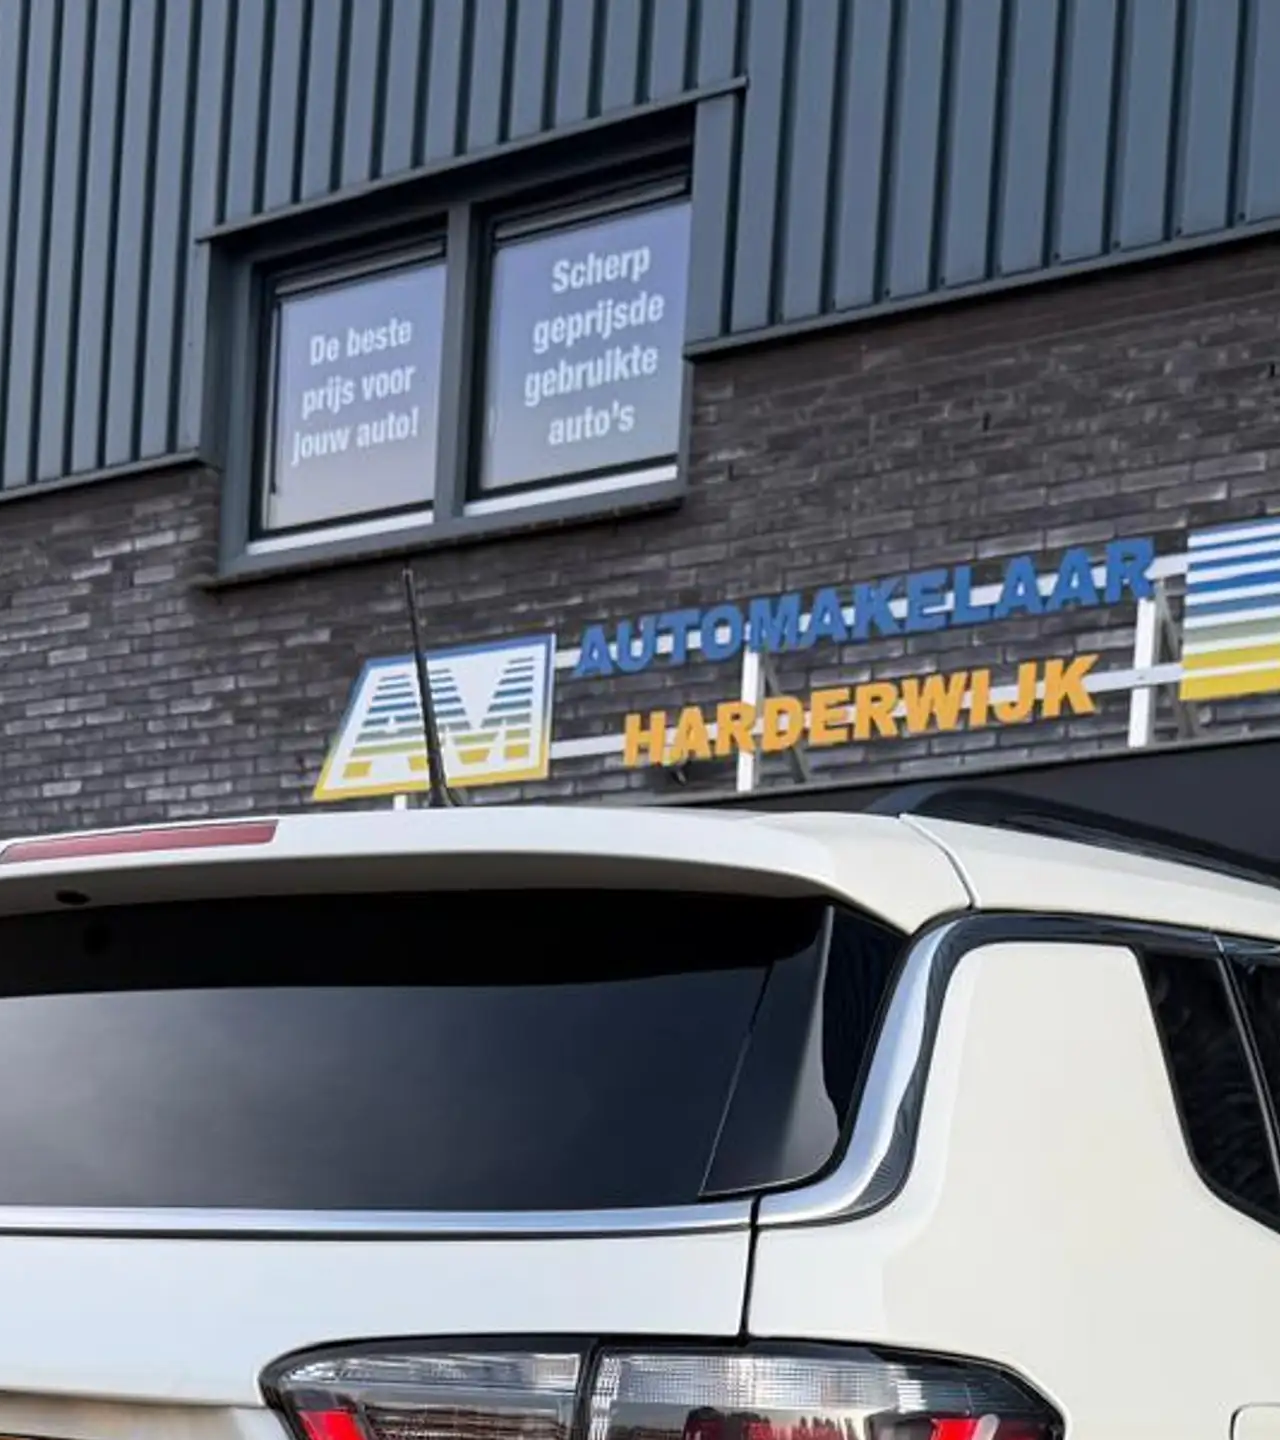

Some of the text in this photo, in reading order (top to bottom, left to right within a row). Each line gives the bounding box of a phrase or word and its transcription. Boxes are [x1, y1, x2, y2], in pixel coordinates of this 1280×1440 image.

[551, 246, 651, 294] Scherp
[310, 317, 413, 366] De beste
[532, 291, 666, 354] geprijsde
[301, 365, 416, 420] prijs voor
[524, 346, 658, 407] gebruikte
[291, 407, 420, 466] jouw auto!
[547, 403, 636, 446] auto's
[571, 536, 1157, 678] AUTOMAKELAAR
[623, 654, 1101, 767] HARDERWIJK
